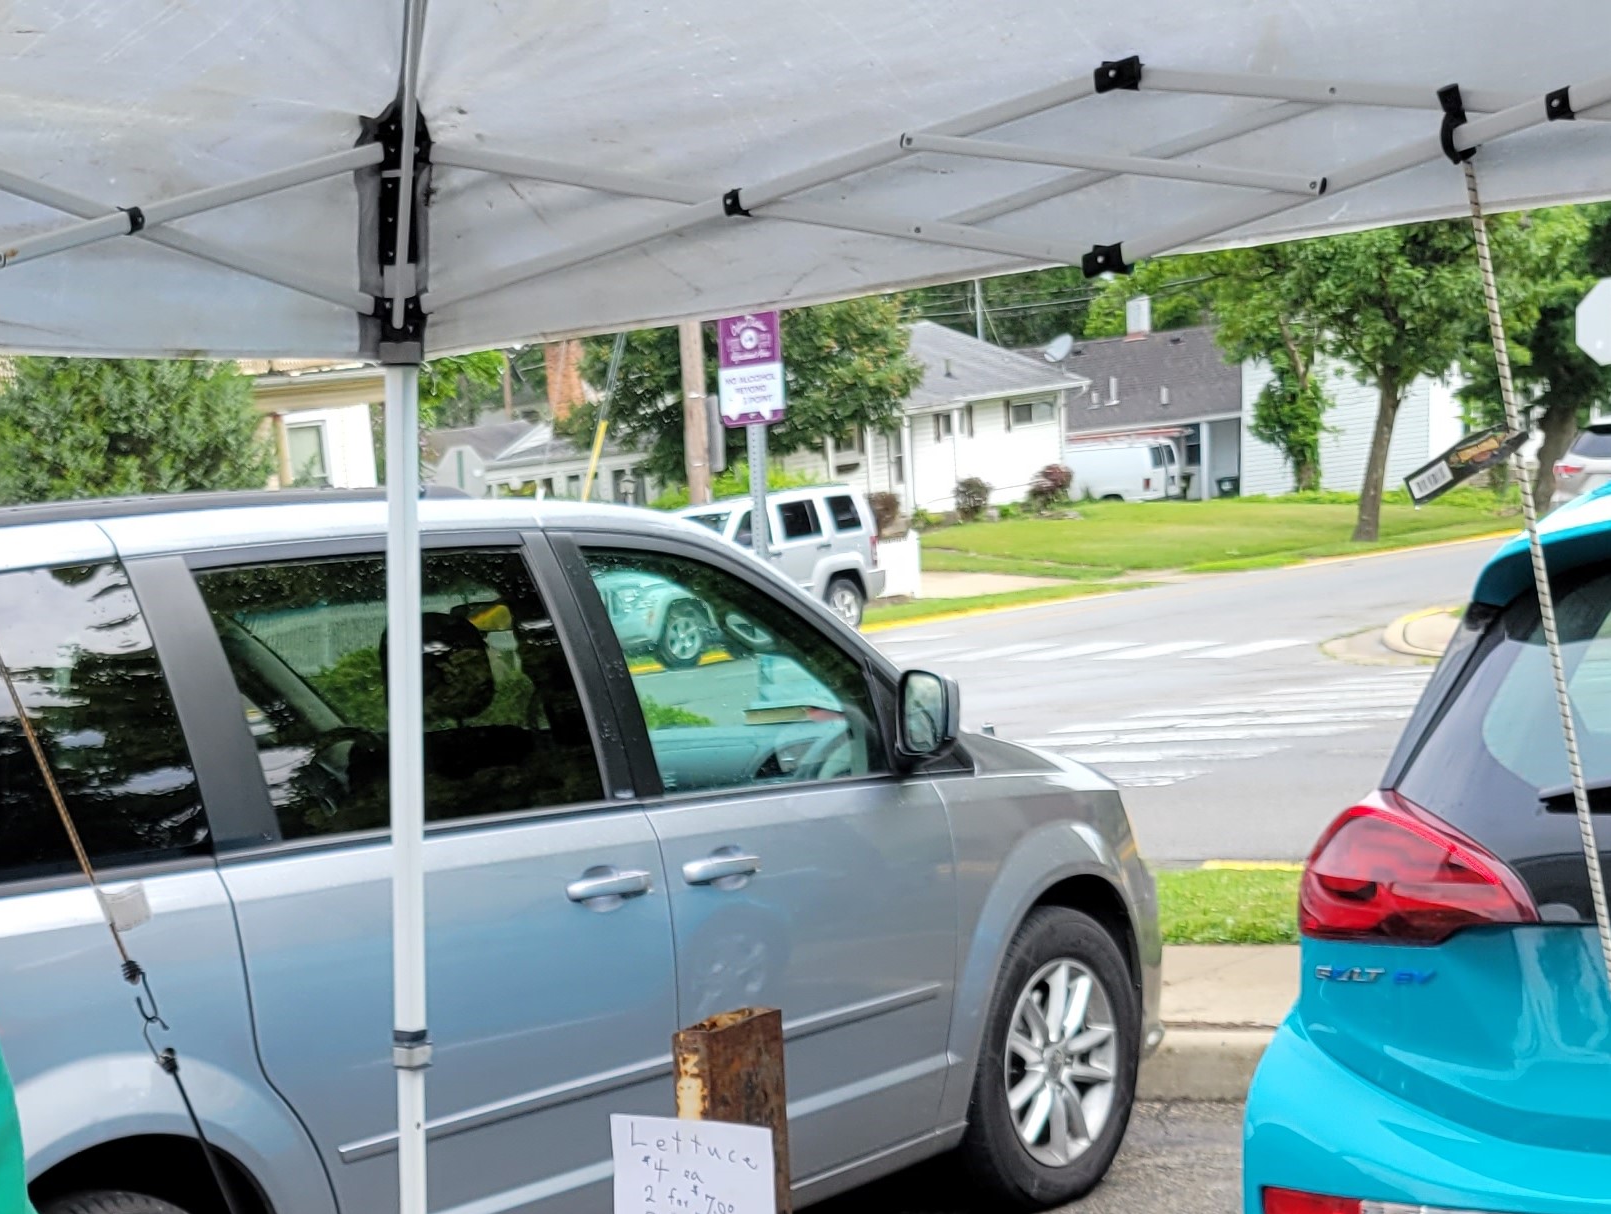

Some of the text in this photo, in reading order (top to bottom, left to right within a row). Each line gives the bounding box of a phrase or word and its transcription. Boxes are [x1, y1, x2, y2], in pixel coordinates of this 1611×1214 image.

[630, 1121, 757, 1170] Lettuce
[684, 1169, 704, 1184] ea
[644, 1185, 656, 1203] 2
[667, 1187, 688, 1209] for
